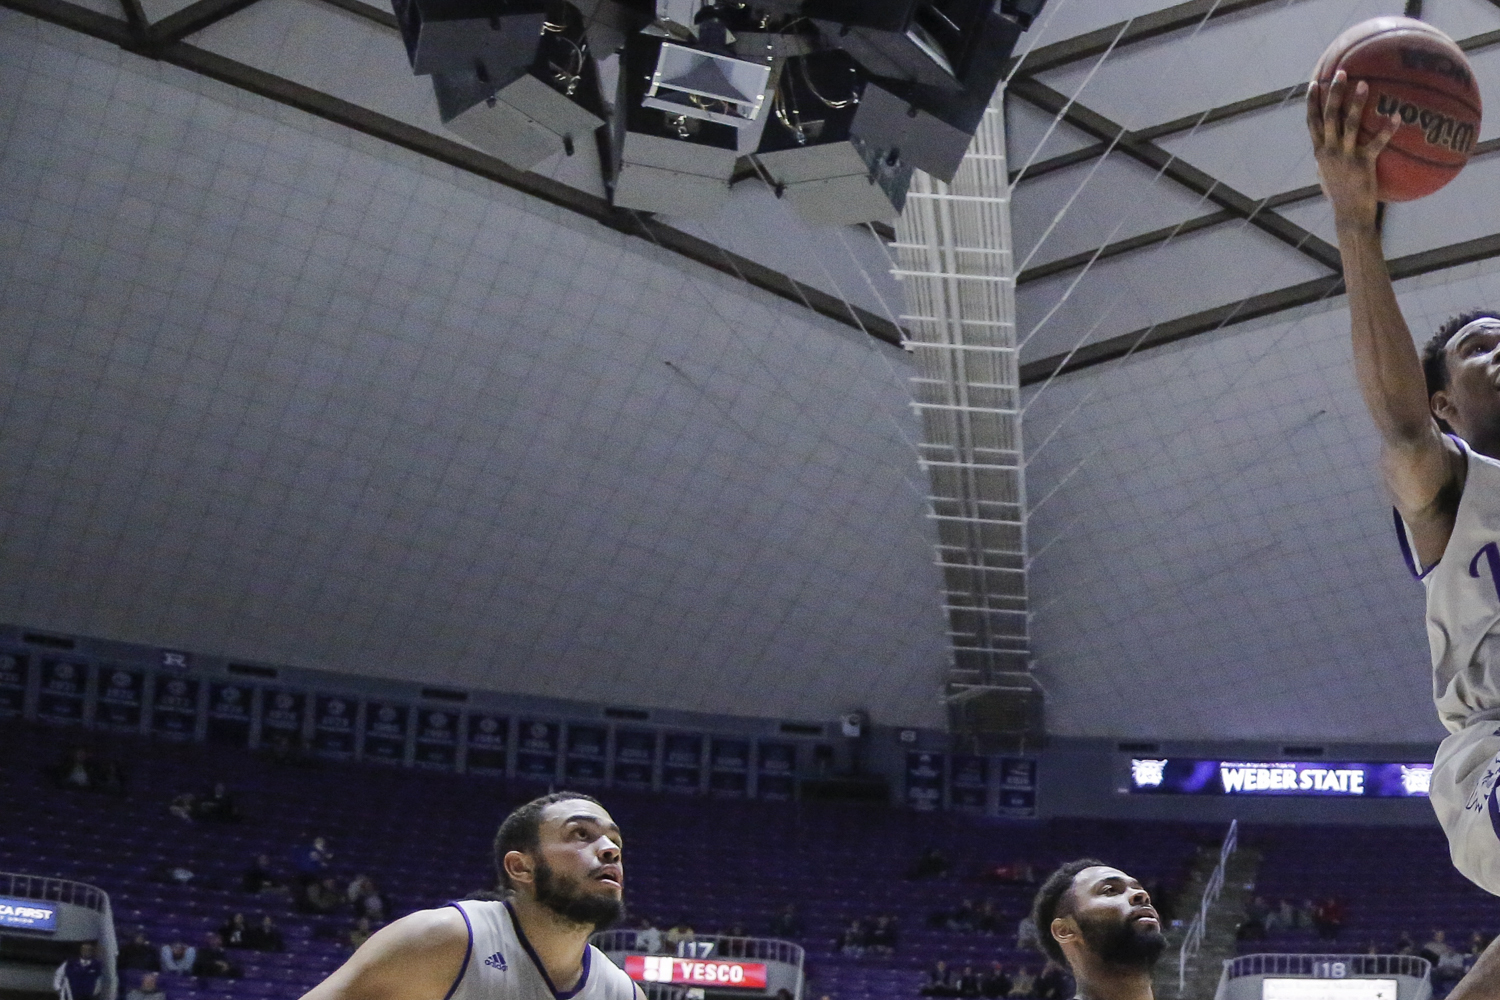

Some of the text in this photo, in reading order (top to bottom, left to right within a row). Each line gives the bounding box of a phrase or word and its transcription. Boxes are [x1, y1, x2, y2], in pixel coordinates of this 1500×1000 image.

[1375, 92, 1475, 152] Wilson
[1220, 767, 1364, 794] WEBER STATE
[687, 941, 714, 959] 17
[681, 962, 744, 983] YESCO
[1322, 962, 1346, 978] 18
